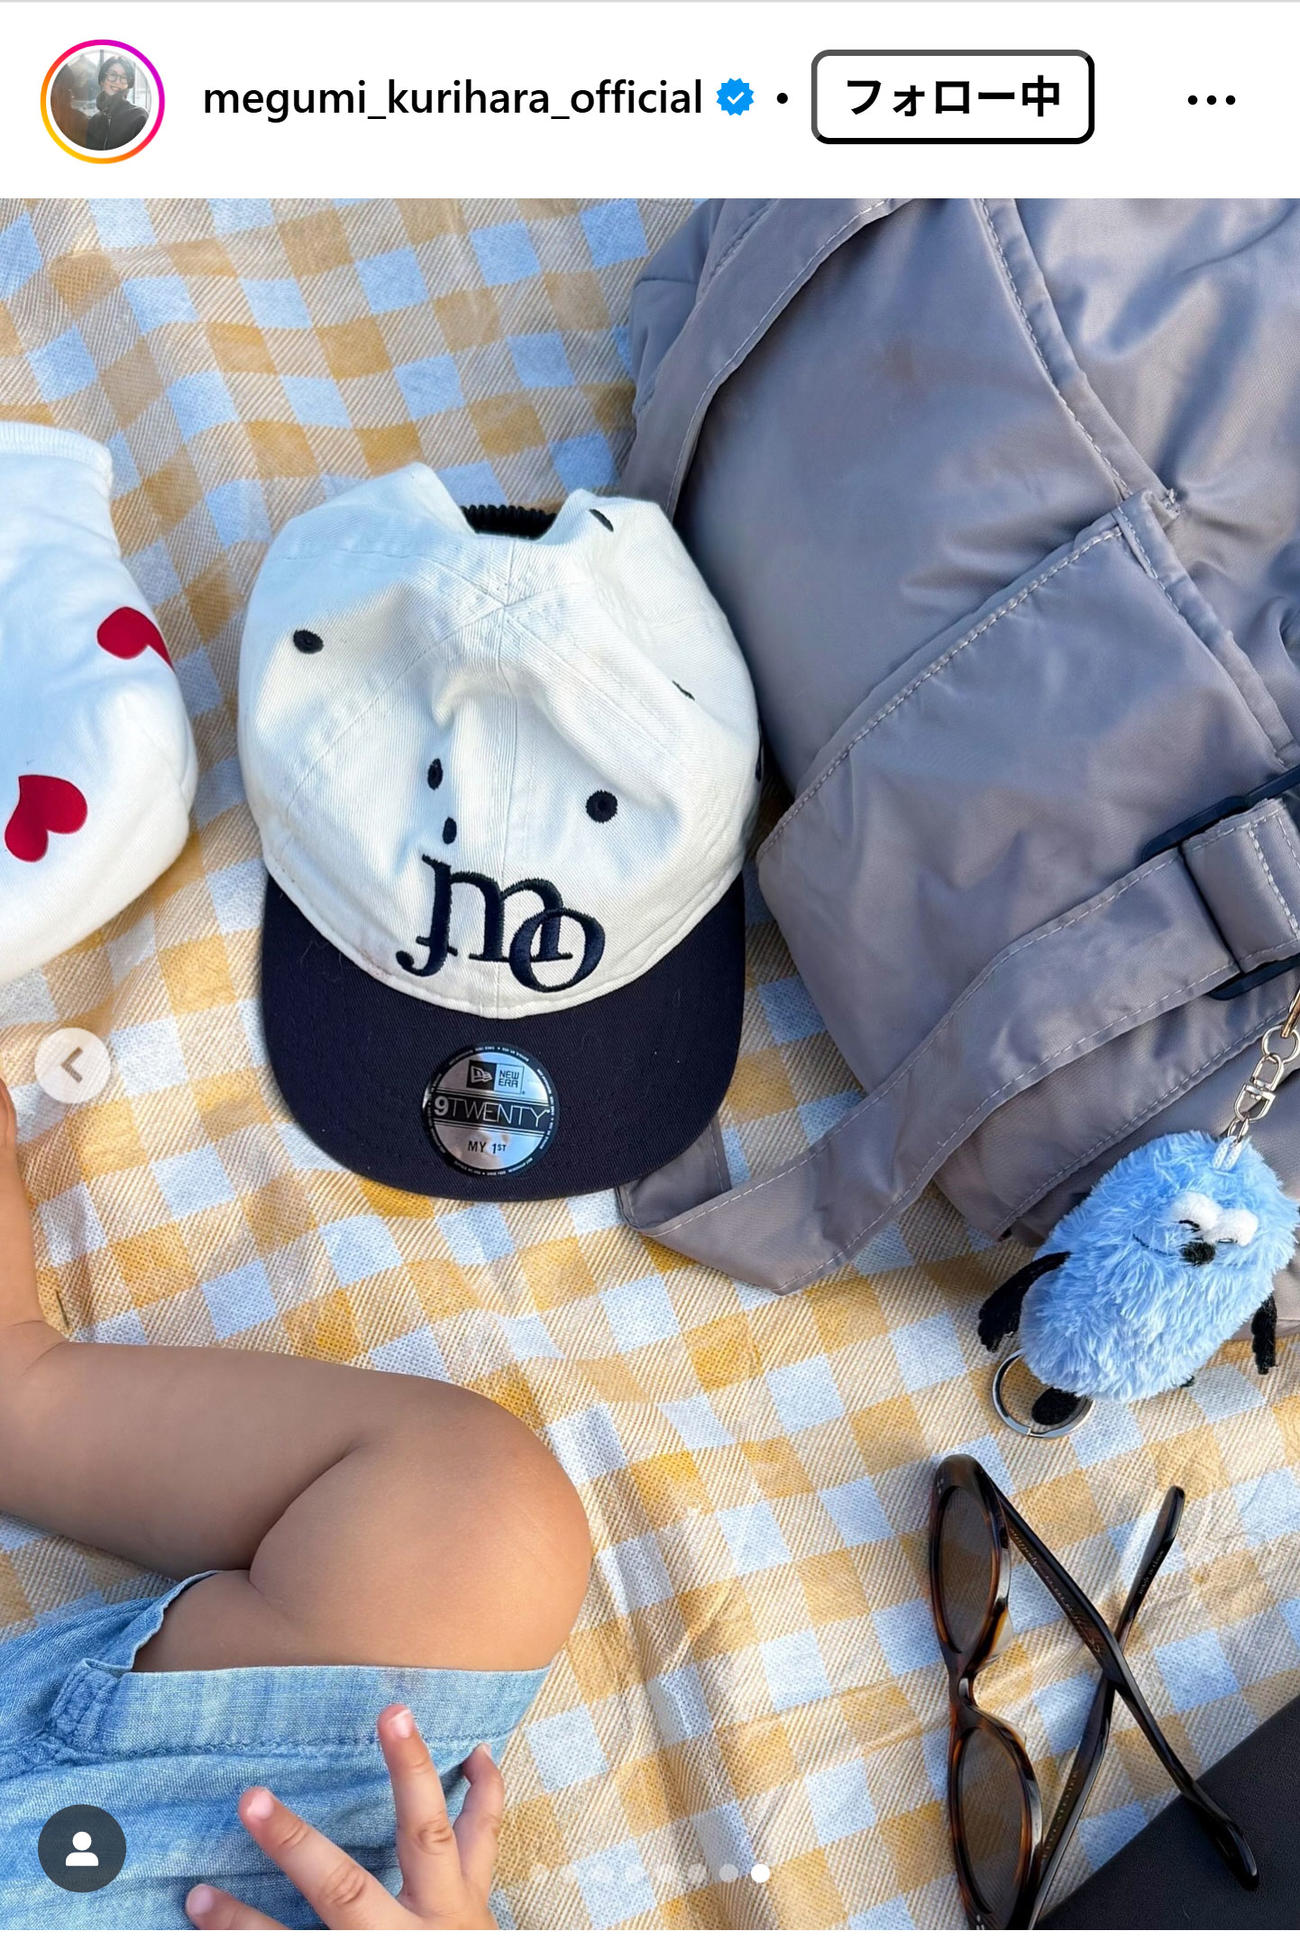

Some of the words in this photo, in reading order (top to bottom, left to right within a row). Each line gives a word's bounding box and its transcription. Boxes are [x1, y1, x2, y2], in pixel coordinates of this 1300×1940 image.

[499, 1068, 520, 1079] NEW
[498, 1079, 519, 1088] ERA
[433, 1096, 549, 1128] 9TWENTY
[467, 1140, 487, 1153] MY
